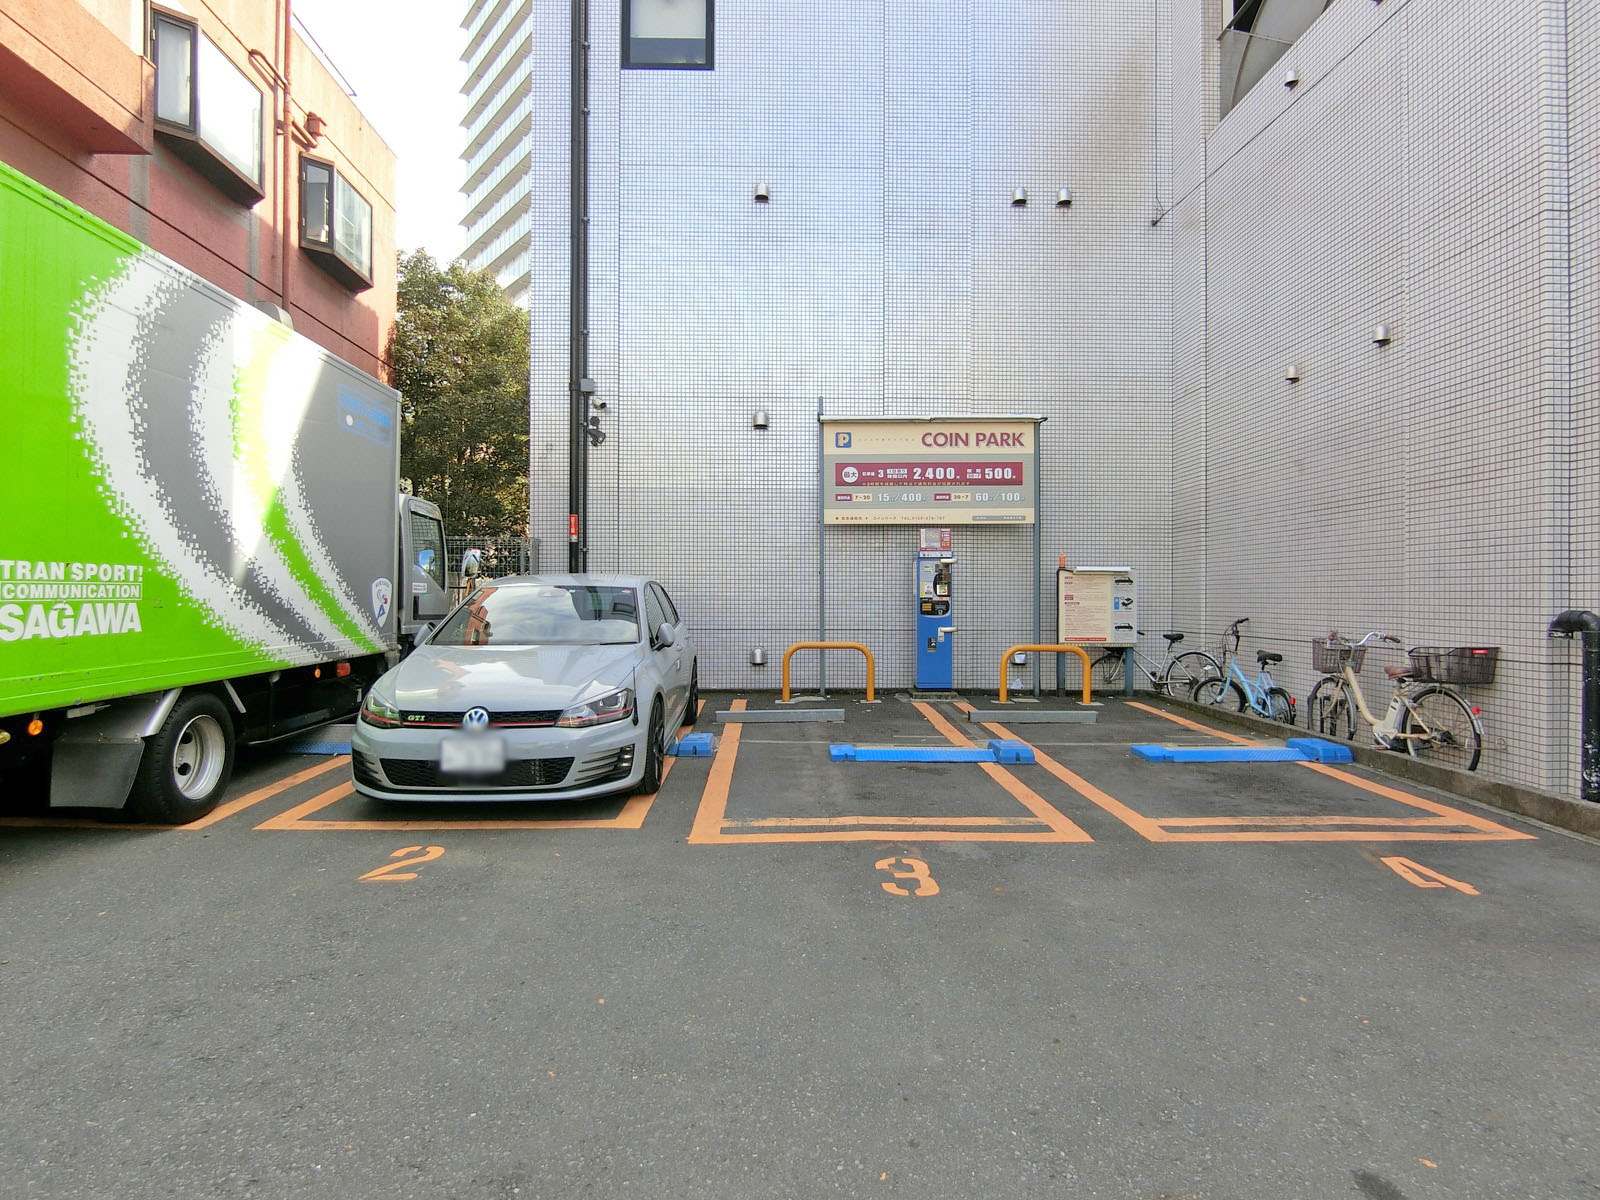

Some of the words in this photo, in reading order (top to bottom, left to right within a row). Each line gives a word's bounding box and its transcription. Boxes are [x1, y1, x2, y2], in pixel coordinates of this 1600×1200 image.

[921, 432, 969, 447] COIN
[975, 432, 1025, 447] PARK
[877, 469, 884, 478] 3
[2, 583, 140, 599] COMMUNICATION
[0, 602, 142, 642] SAGAWA
[407, 714, 426, 722] GTI
[357, 845, 446, 882] 2
[874, 856, 941, 897] 3
[1379, 856, 1481, 896] 4
